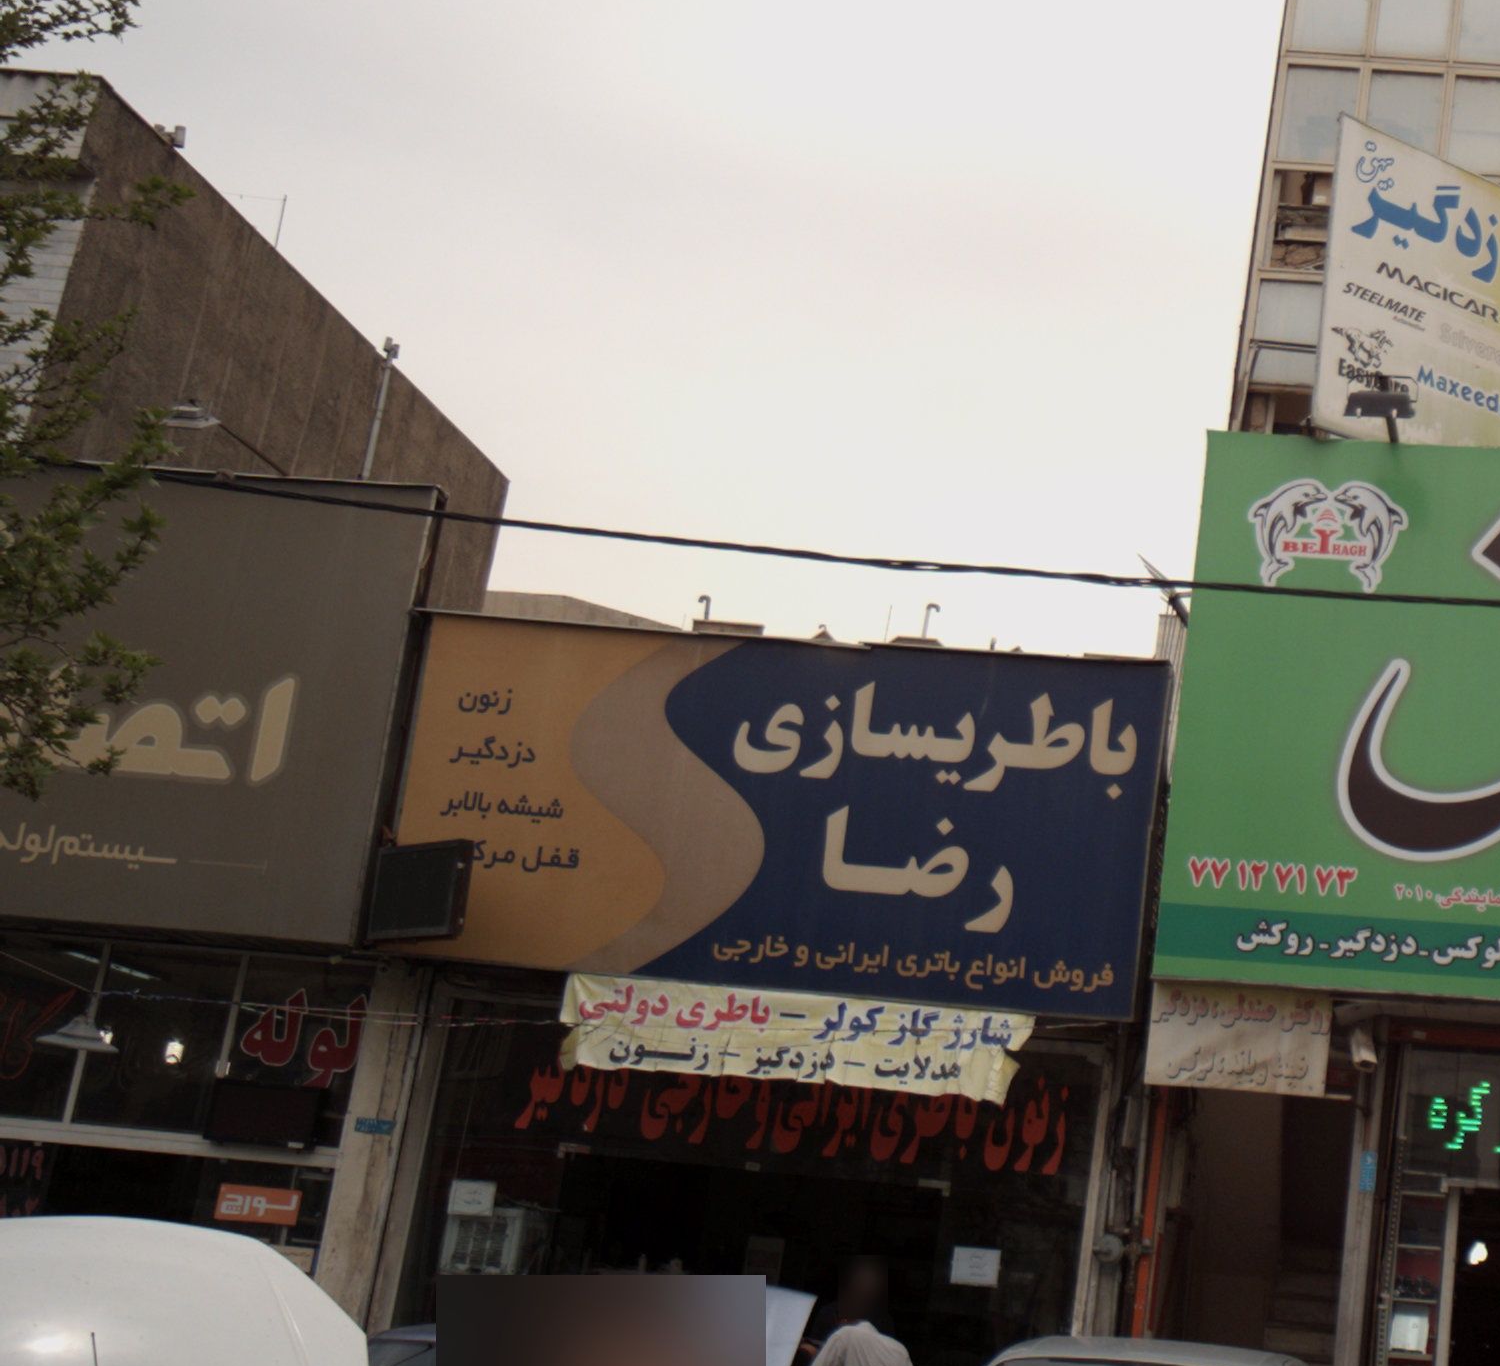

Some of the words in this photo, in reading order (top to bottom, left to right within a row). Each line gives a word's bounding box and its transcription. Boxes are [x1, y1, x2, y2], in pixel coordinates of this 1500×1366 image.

[1343, 282, 1427, 323] STEELMATE
[1376, 262, 1500, 323] MAGICAR
[1282, 528, 1368, 557] BEYHAGH
[458, 688, 513, 715] زنون
[450, 736, 536, 768] دزدگیر
[732, 680, 1138, 800] باطریسازی
[440, 790, 492, 819] بالابر
[497, 795, 565, 823] شیشه
[473, 839, 516, 869] مرک
[521, 846, 580, 873] قفل
[822, 805, 1014, 933] رضا
[711, 934, 790, 964] خارجی
[1236, 920, 1314, 956] روکش
[1330, 928, 1419, 962] دزدگیر
[795, 943, 809, 968] و
[815, 942, 889, 974] ایرانی
[897, 949, 960, 981] باتری
[964, 953, 1026, 990] انواع
[1033, 959, 1114, 992] فروش
[578, 985, 669, 1025] دولتی
[676, 993, 771, 1032] باطری
[813, 1002, 885, 1041] کولر
[943, 1015, 1012, 1050] شارژ
[609, 1037, 711, 1071] زنون
